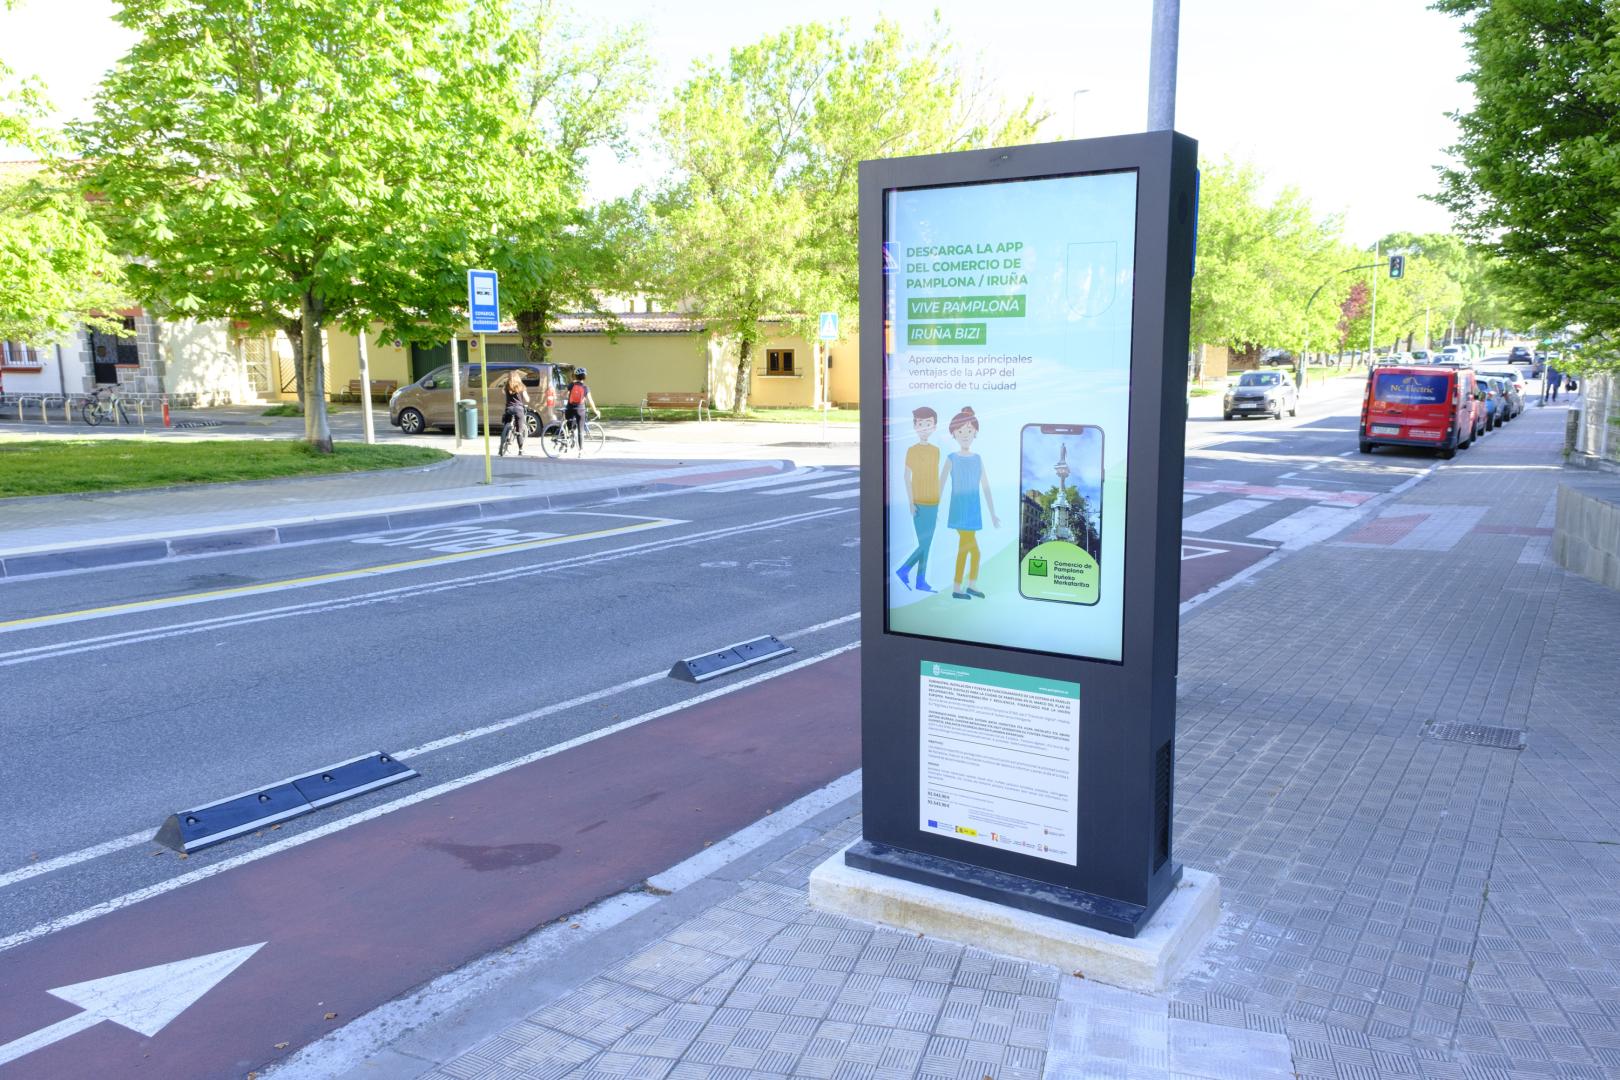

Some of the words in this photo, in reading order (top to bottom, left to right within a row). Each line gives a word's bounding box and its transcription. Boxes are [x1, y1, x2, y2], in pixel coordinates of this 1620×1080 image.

[907, 244, 973, 257] DESCARGA
[976, 243, 992, 254] LA
[997, 242, 1023, 253] APP
[907, 262, 930, 273] DEL
[933, 260, 1000, 272] COMERCIO
[1004, 259, 1021, 269] DE
[907, 278, 976, 289] PAMPLONA
[987, 272, 1028, 286] IRUÑA
[912, 301, 940, 313] VIVE
[943, 300, 1019, 313] PAMPLONA
[911, 326, 951, 340] IRUÑA
[955, 328, 980, 339] BIZI
[909, 355, 959, 366] Aprovecha
[962, 355, 974, 364] las
[978, 355, 1032, 366] principales
[909, 368, 948, 379] ventajas
[951, 368, 962, 376] de
[964, 368, 972, 377] la
[976, 368, 996, 377] APP
[999, 368, 1014, 377] del
[909, 382, 952, 390] comercio
[955, 382, 967, 390] de
[969, 382, 979, 390] tu
[983, 382, 1016, 390] ciudad
[1406, 385, 1434, 393] Electric
[350, 526, 567, 553] BUS
